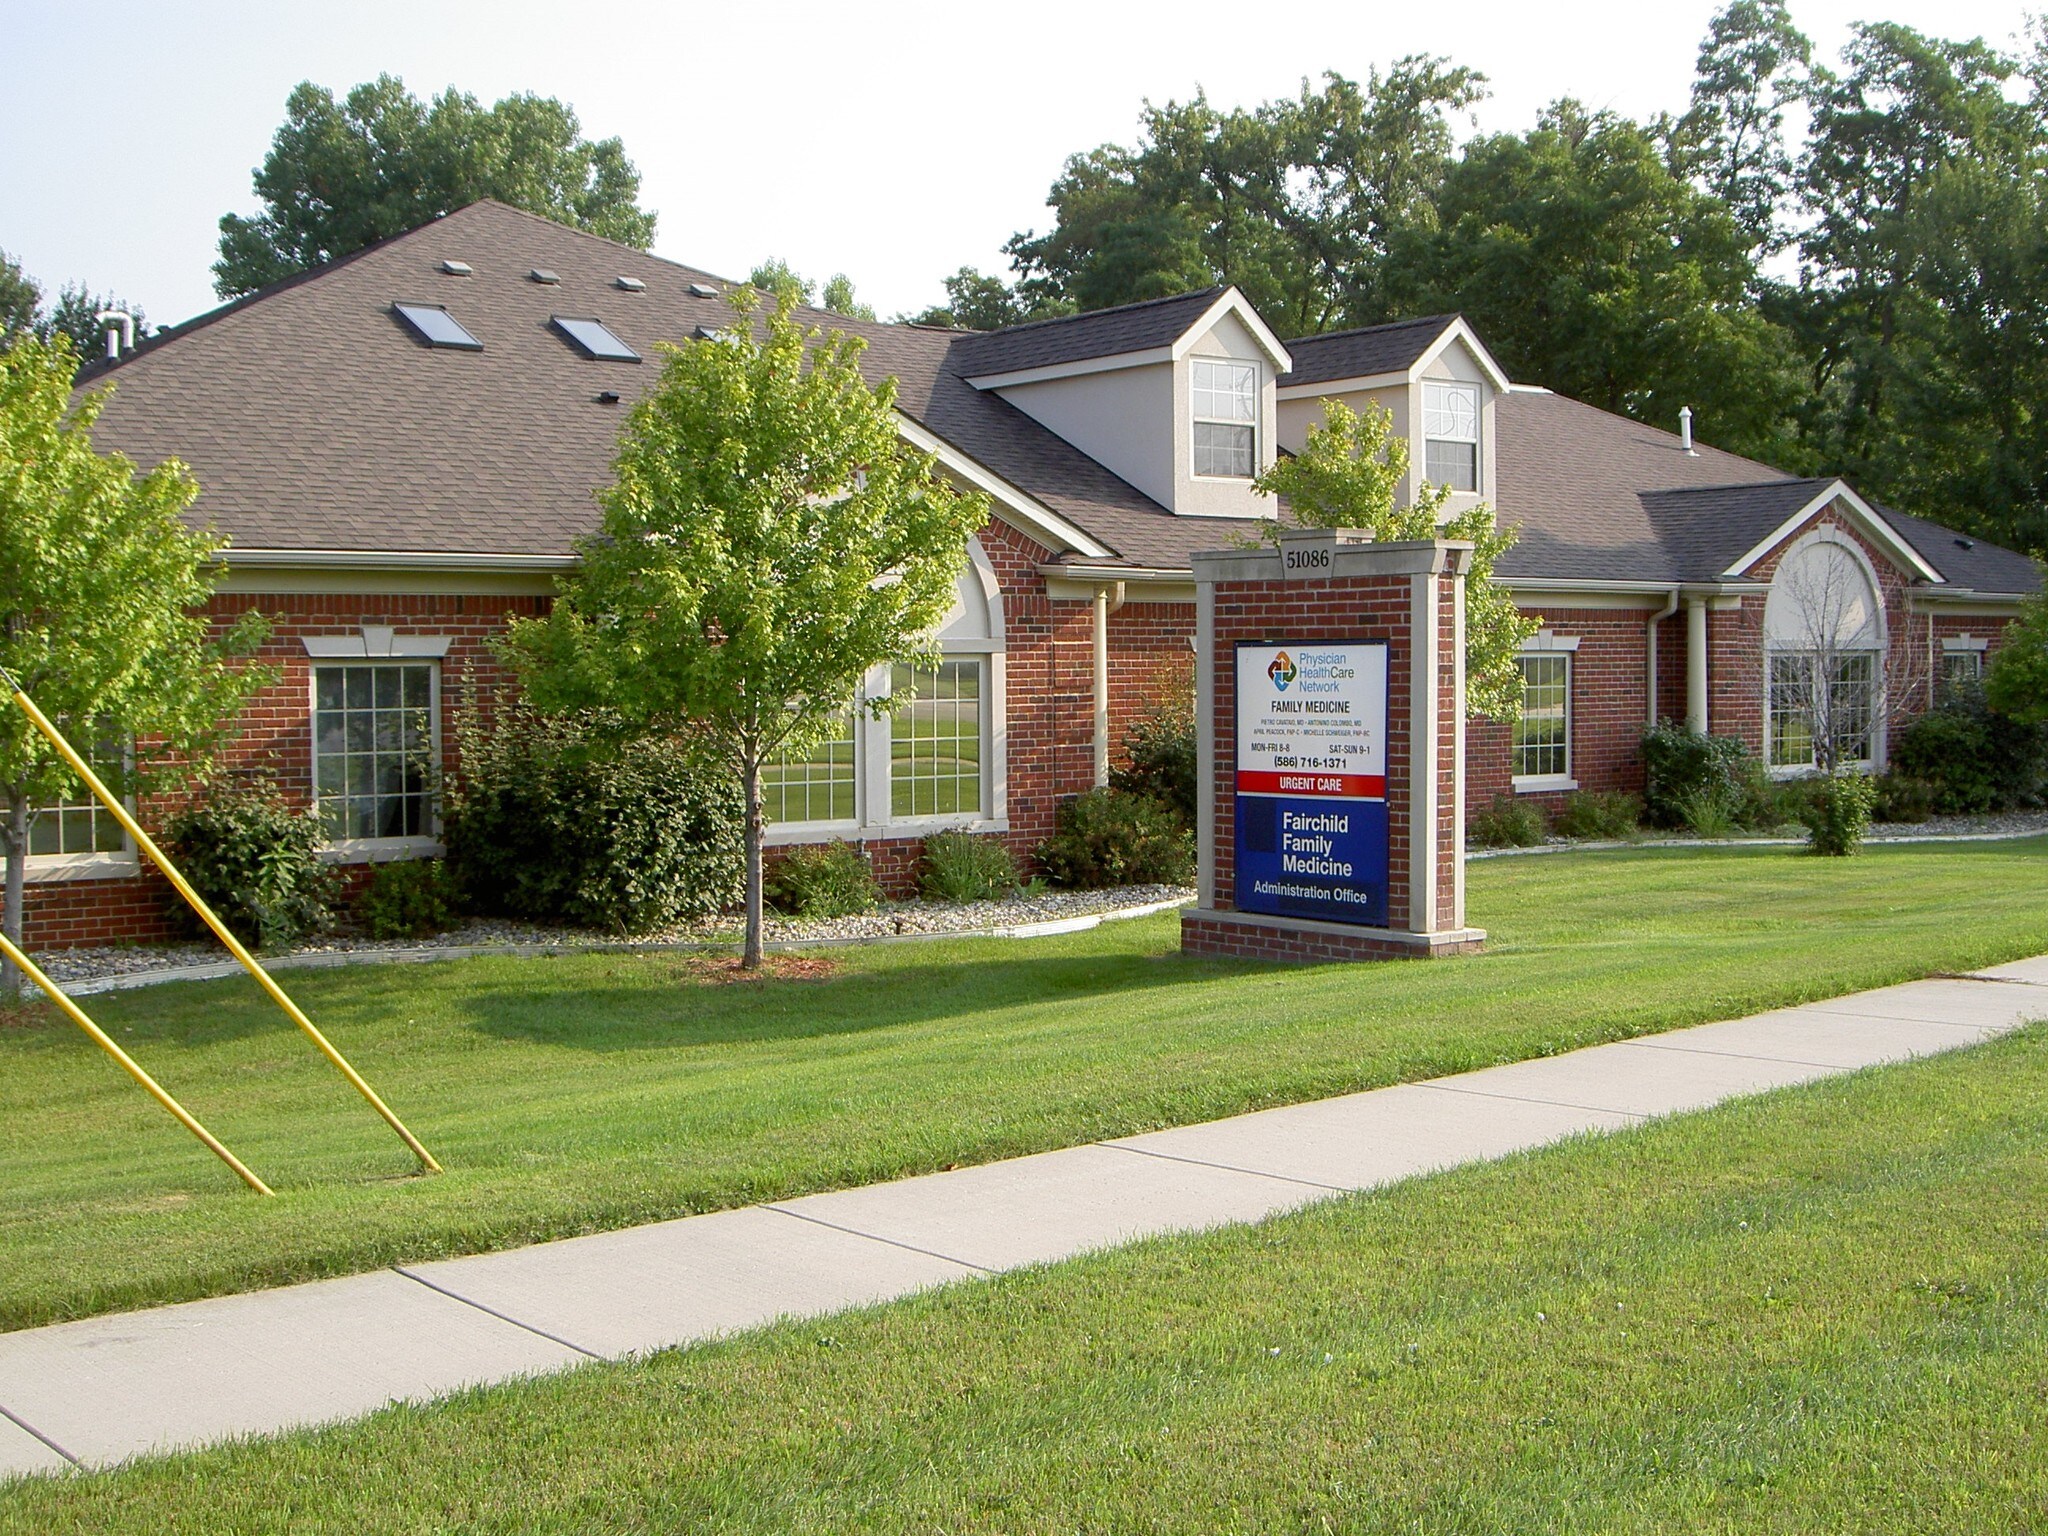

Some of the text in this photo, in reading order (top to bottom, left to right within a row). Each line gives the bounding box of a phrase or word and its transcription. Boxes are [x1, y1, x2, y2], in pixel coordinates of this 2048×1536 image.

[1287, 549, 1329, 569] 51086
[1299, 652, 1346, 667] Physician
[1299, 666, 1354, 679] HealthCare
[1299, 681, 1340, 692] Network
[1271, 700, 1350, 713] FAMILY MEDICINE
[1251, 743, 1370, 754] MON-FRI 8-8 SAT-SUN 9-1
[1274, 755, 1347, 769] (586) 716-1371
[1279, 776, 1342, 792] URGENT CARE
[1283, 811, 1349, 834] Fairchild
[1283, 833, 1332, 857] Family
[1283, 854, 1352, 877] Medicine
[1253, 880, 1368, 904] Administration Office
